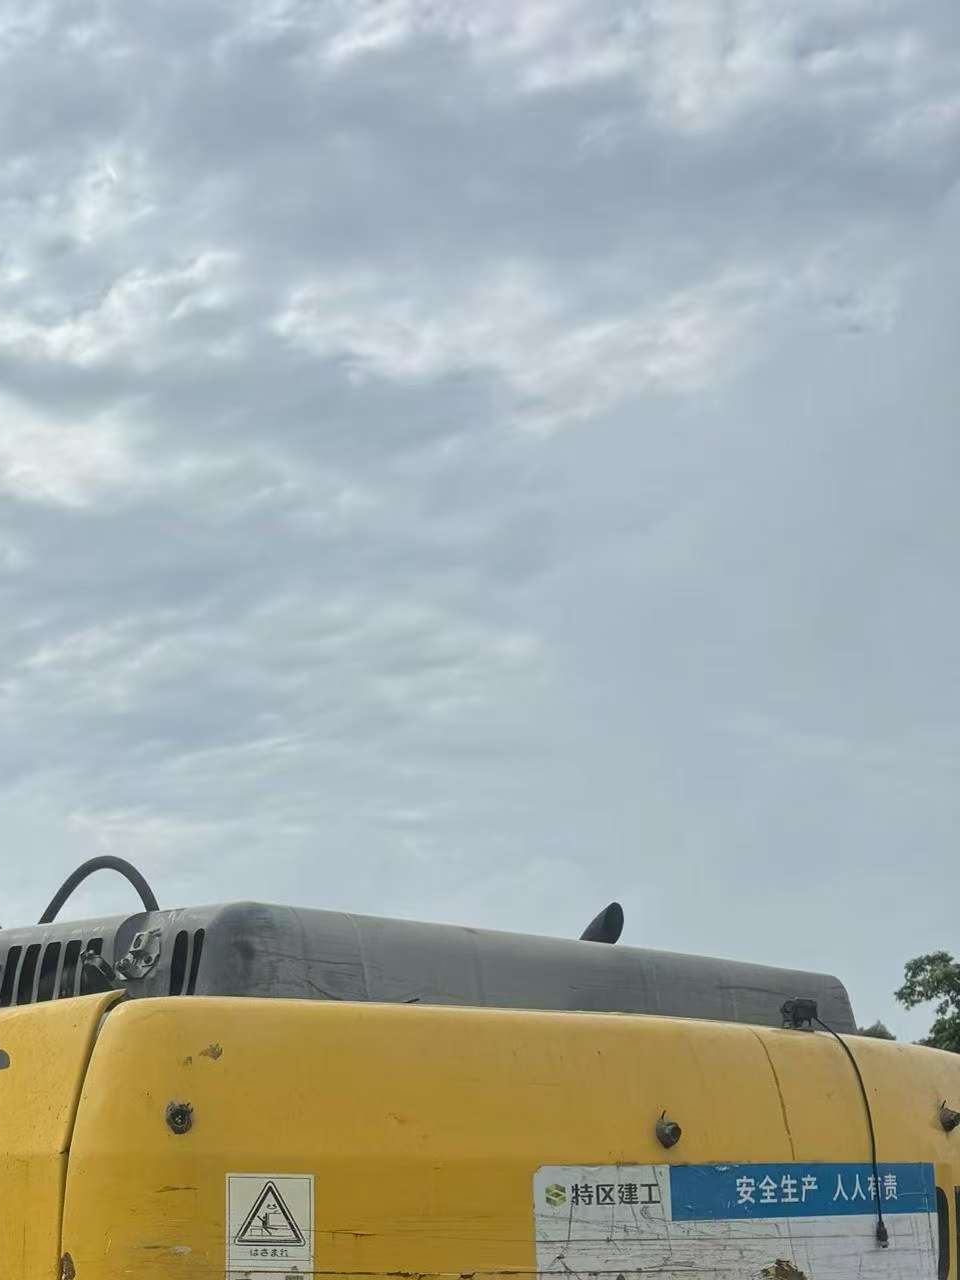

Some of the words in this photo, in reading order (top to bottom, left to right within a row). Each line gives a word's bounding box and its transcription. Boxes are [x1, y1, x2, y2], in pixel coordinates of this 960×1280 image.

[571, 1182, 661, 1207] 特区建工
[736, 1173, 819, 1205] 安全生产
[833, 1173, 898, 1201] 人人有责
